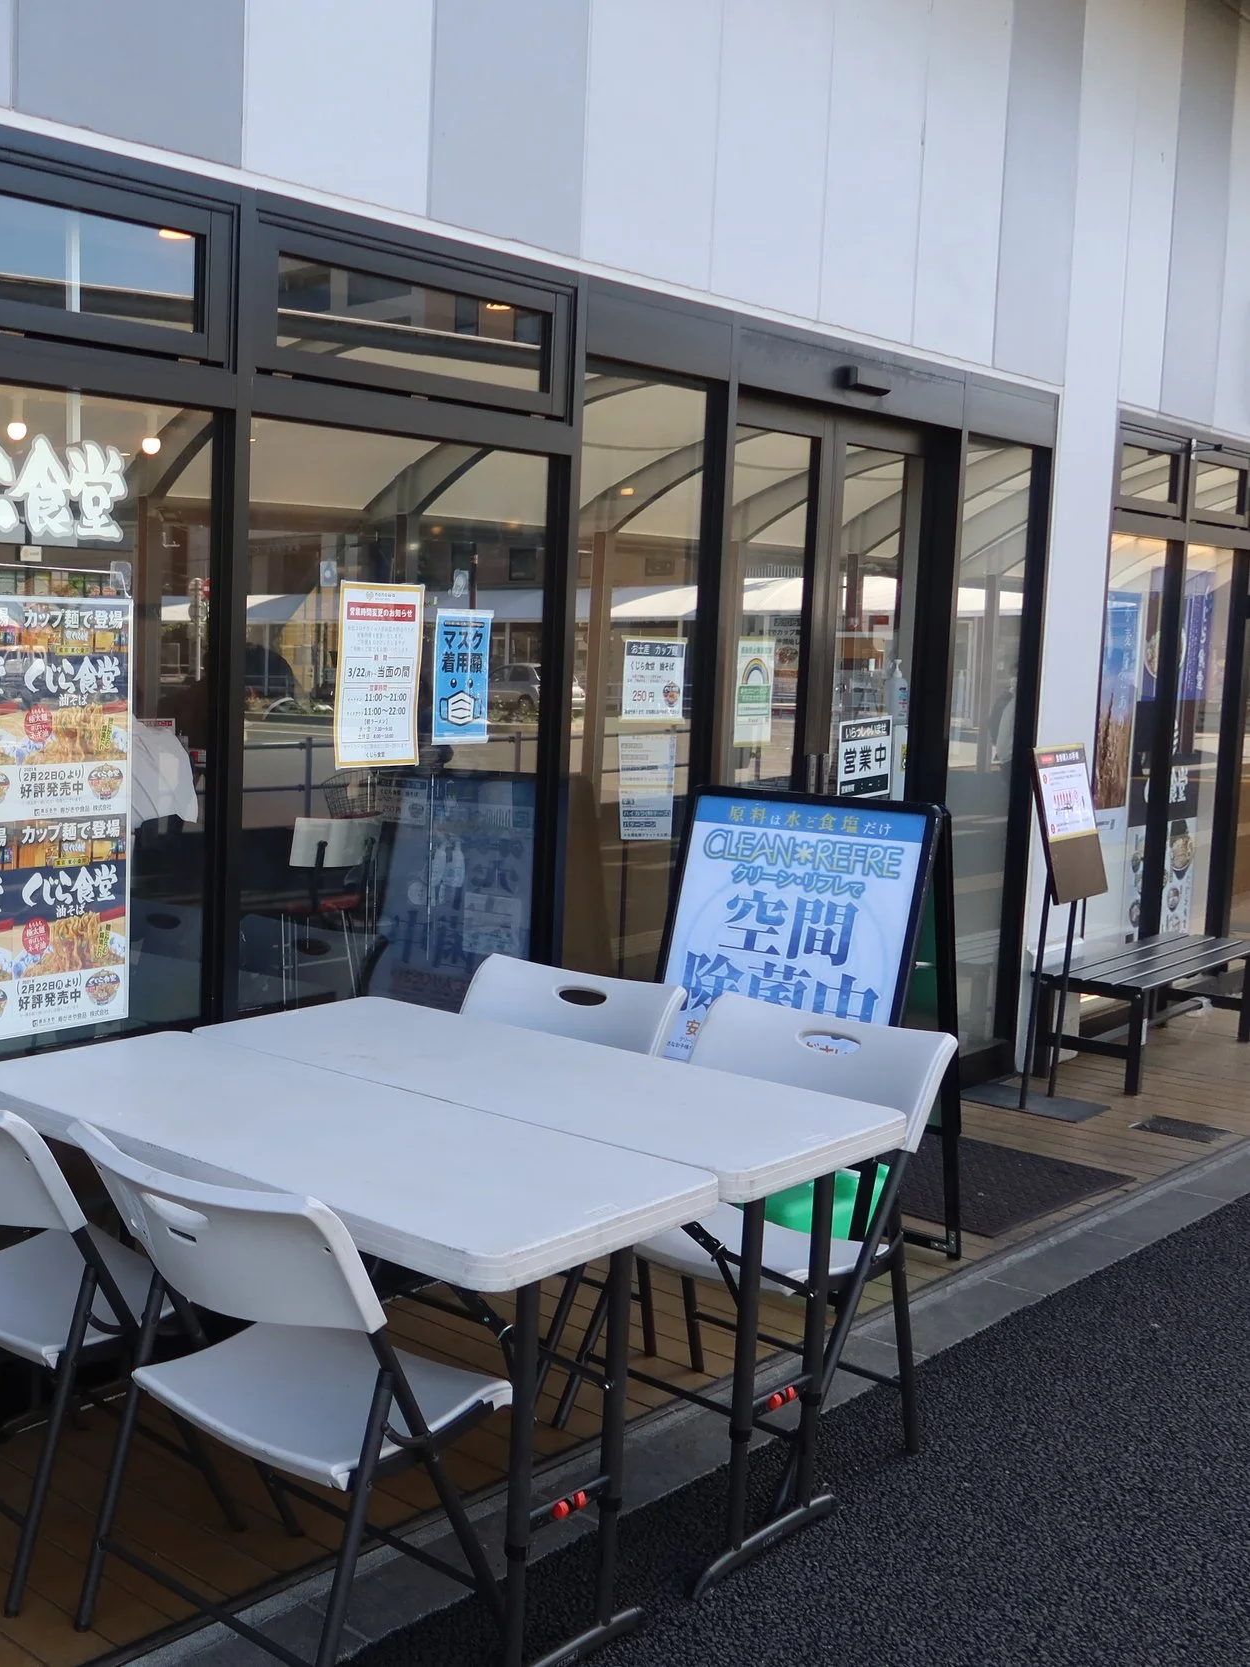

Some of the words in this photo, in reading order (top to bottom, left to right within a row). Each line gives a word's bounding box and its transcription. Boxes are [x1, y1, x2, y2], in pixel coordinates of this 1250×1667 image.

[24, 608, 123, 629] カップ麺で登場
[350, 606, 413, 617] 営業時間変更のお知らせ
[443, 630, 483, 650] マスク
[441, 651, 483, 674] 着用願
[631, 661, 656, 671] くじら食堂
[24, 655, 121, 694] くじら食堂
[59, 693, 88, 706] 油そば
[844, 743, 887, 774] 営業中
[20, 780, 84, 799] 好評発売中
[22, 819, 120, 844] カップ麺で登場
[729, 804, 893, 837] 原料は水と食塩だけ
[22, 864, 118, 907] くじら食堂
[731, 863, 866, 899] クリーン・リフレで
[56, 902, 86, 918] 油そば
[718, 889, 859, 967] 空間
[18, 988, 82, 1011] 好評発売中
